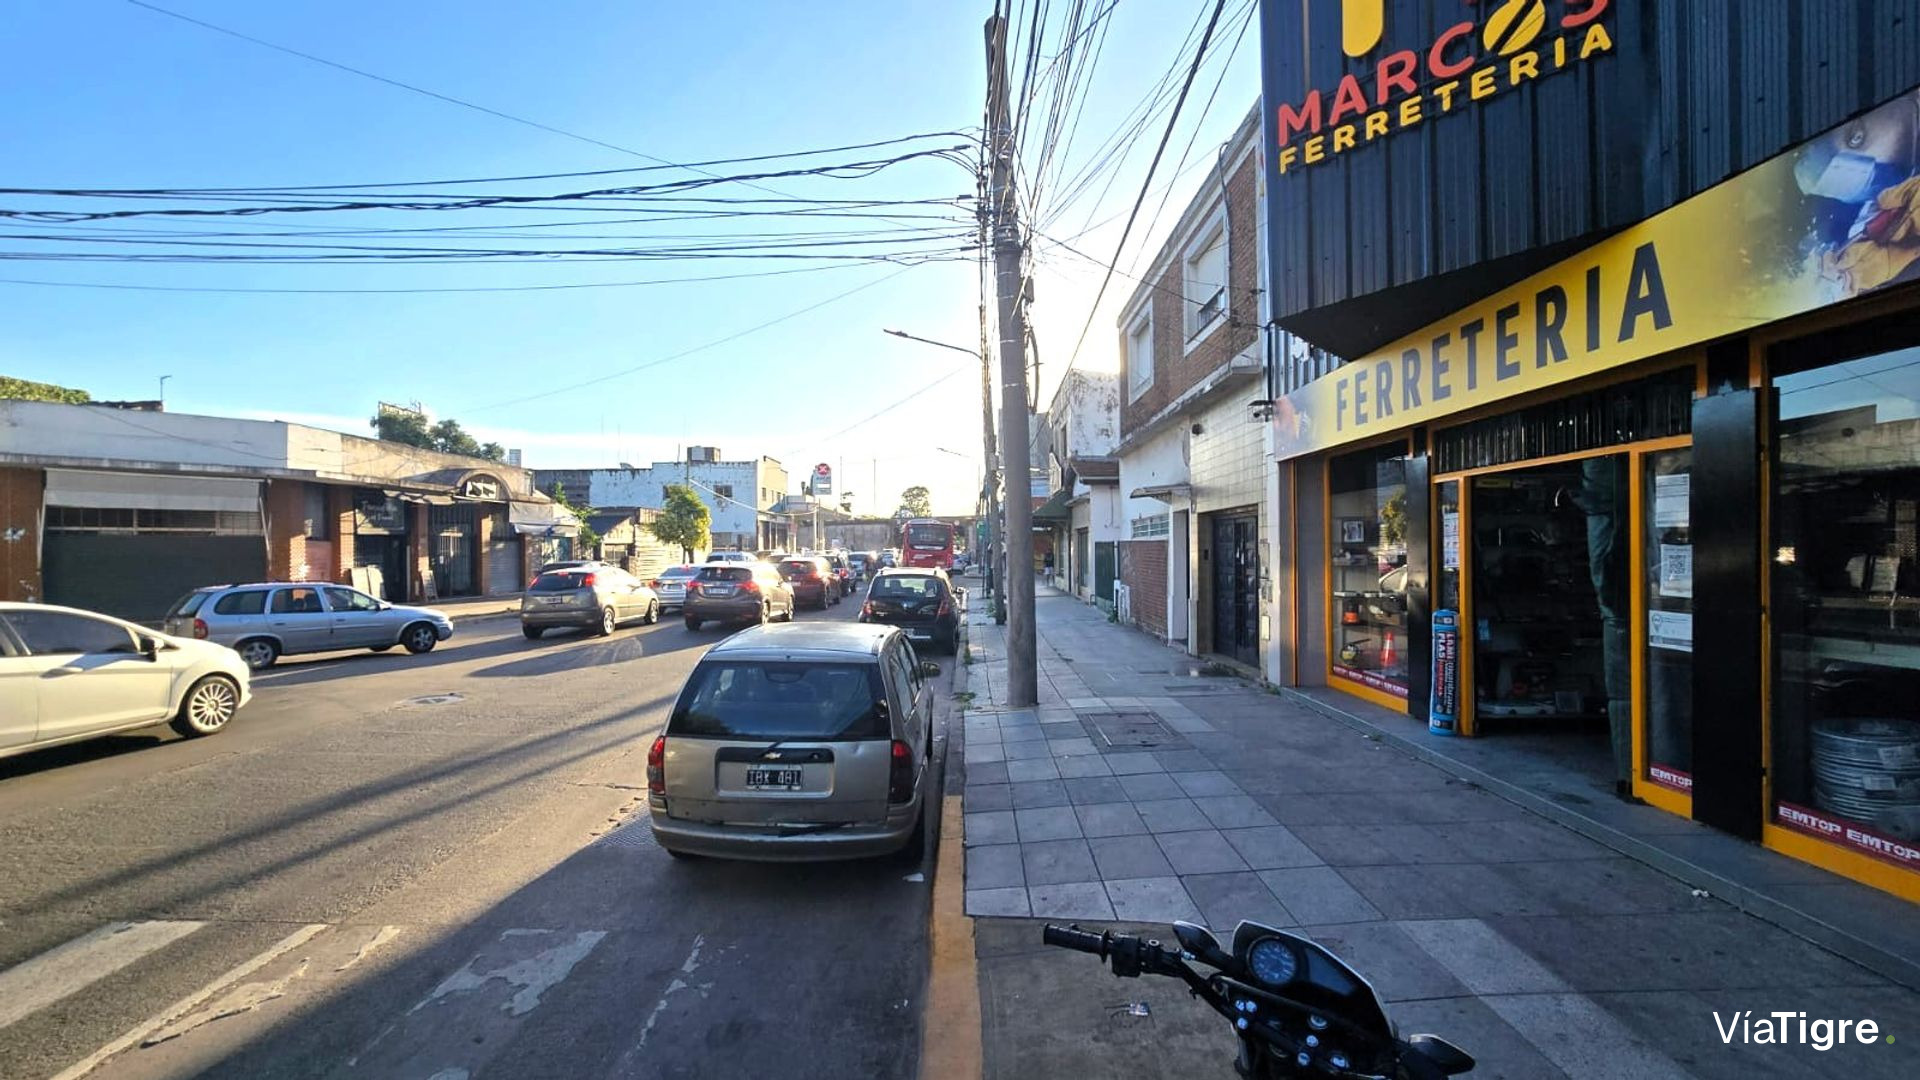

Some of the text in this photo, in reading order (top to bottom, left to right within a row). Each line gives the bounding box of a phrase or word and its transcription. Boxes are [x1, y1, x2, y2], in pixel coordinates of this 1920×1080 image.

[1280, 23, 1612, 174] FERRETERIA
[1336, 241, 1673, 432] FERRETERIA
[1650, 767, 1693, 788] EMTOP
[1778, 805, 1842, 834] EMTOP
